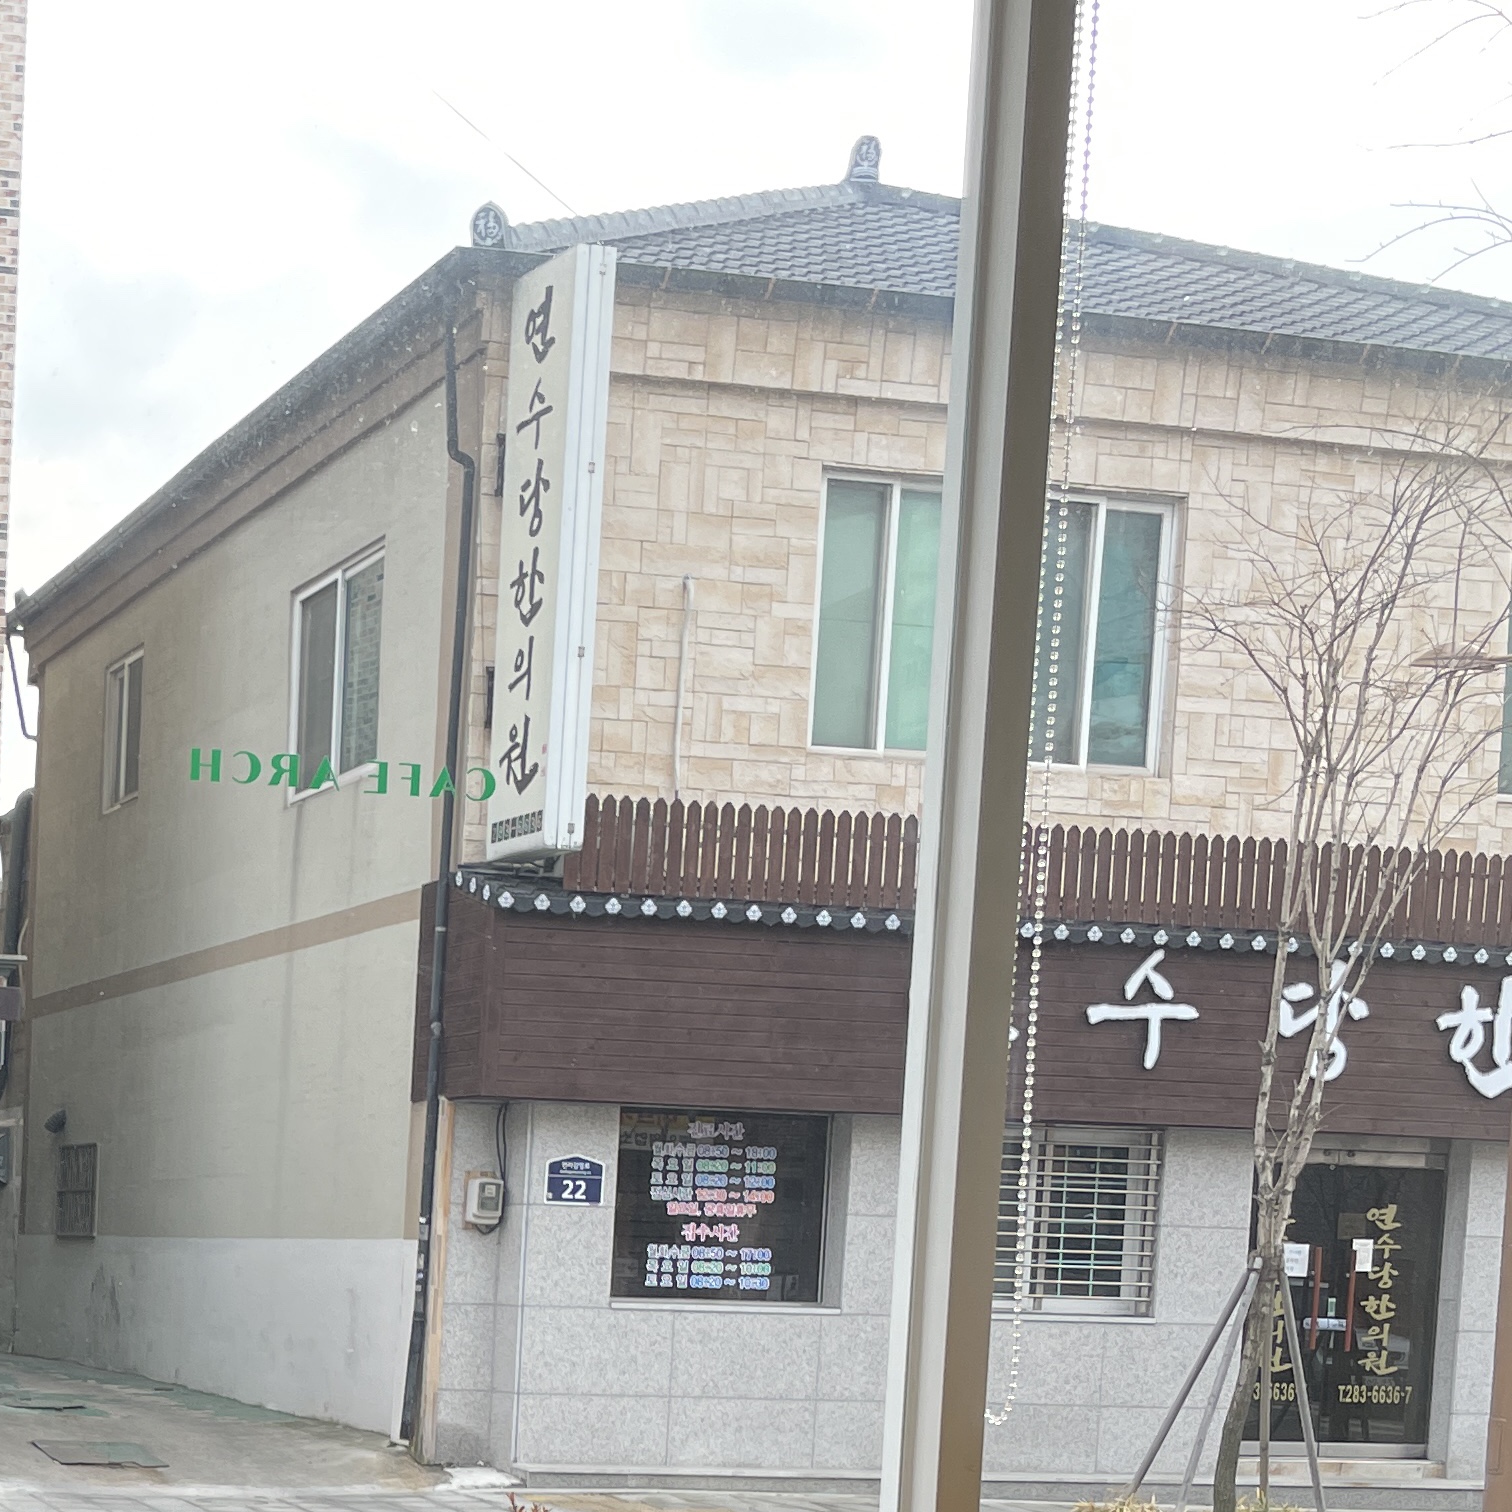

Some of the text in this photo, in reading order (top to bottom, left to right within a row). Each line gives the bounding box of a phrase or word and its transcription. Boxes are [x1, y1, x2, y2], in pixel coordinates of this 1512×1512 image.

[499, 285, 556, 796] 연수당한의원
[561, 1179, 587, 1200] 22
[1357, 1203, 1403, 1376] 연수당한의원
